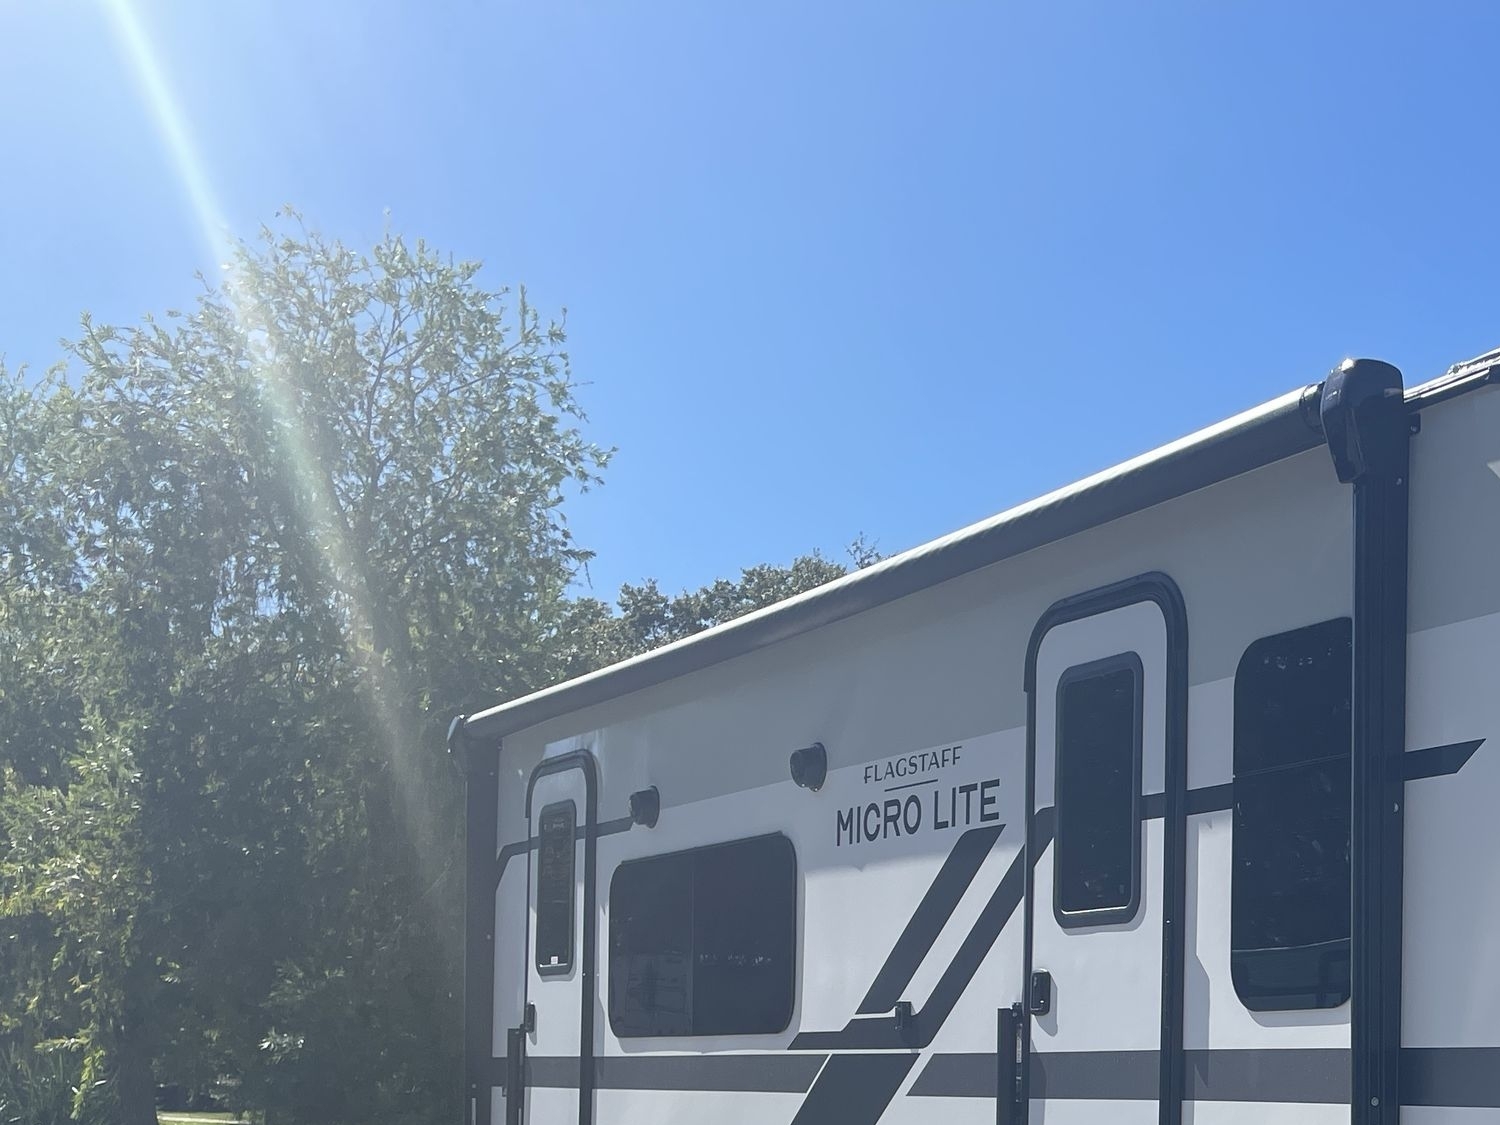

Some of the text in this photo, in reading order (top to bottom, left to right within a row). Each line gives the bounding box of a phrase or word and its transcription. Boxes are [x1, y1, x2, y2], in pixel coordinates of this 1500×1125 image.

[864, 746, 962, 783] FLAGSTAFF
[837, 779, 1000, 846] MICRO LITE
